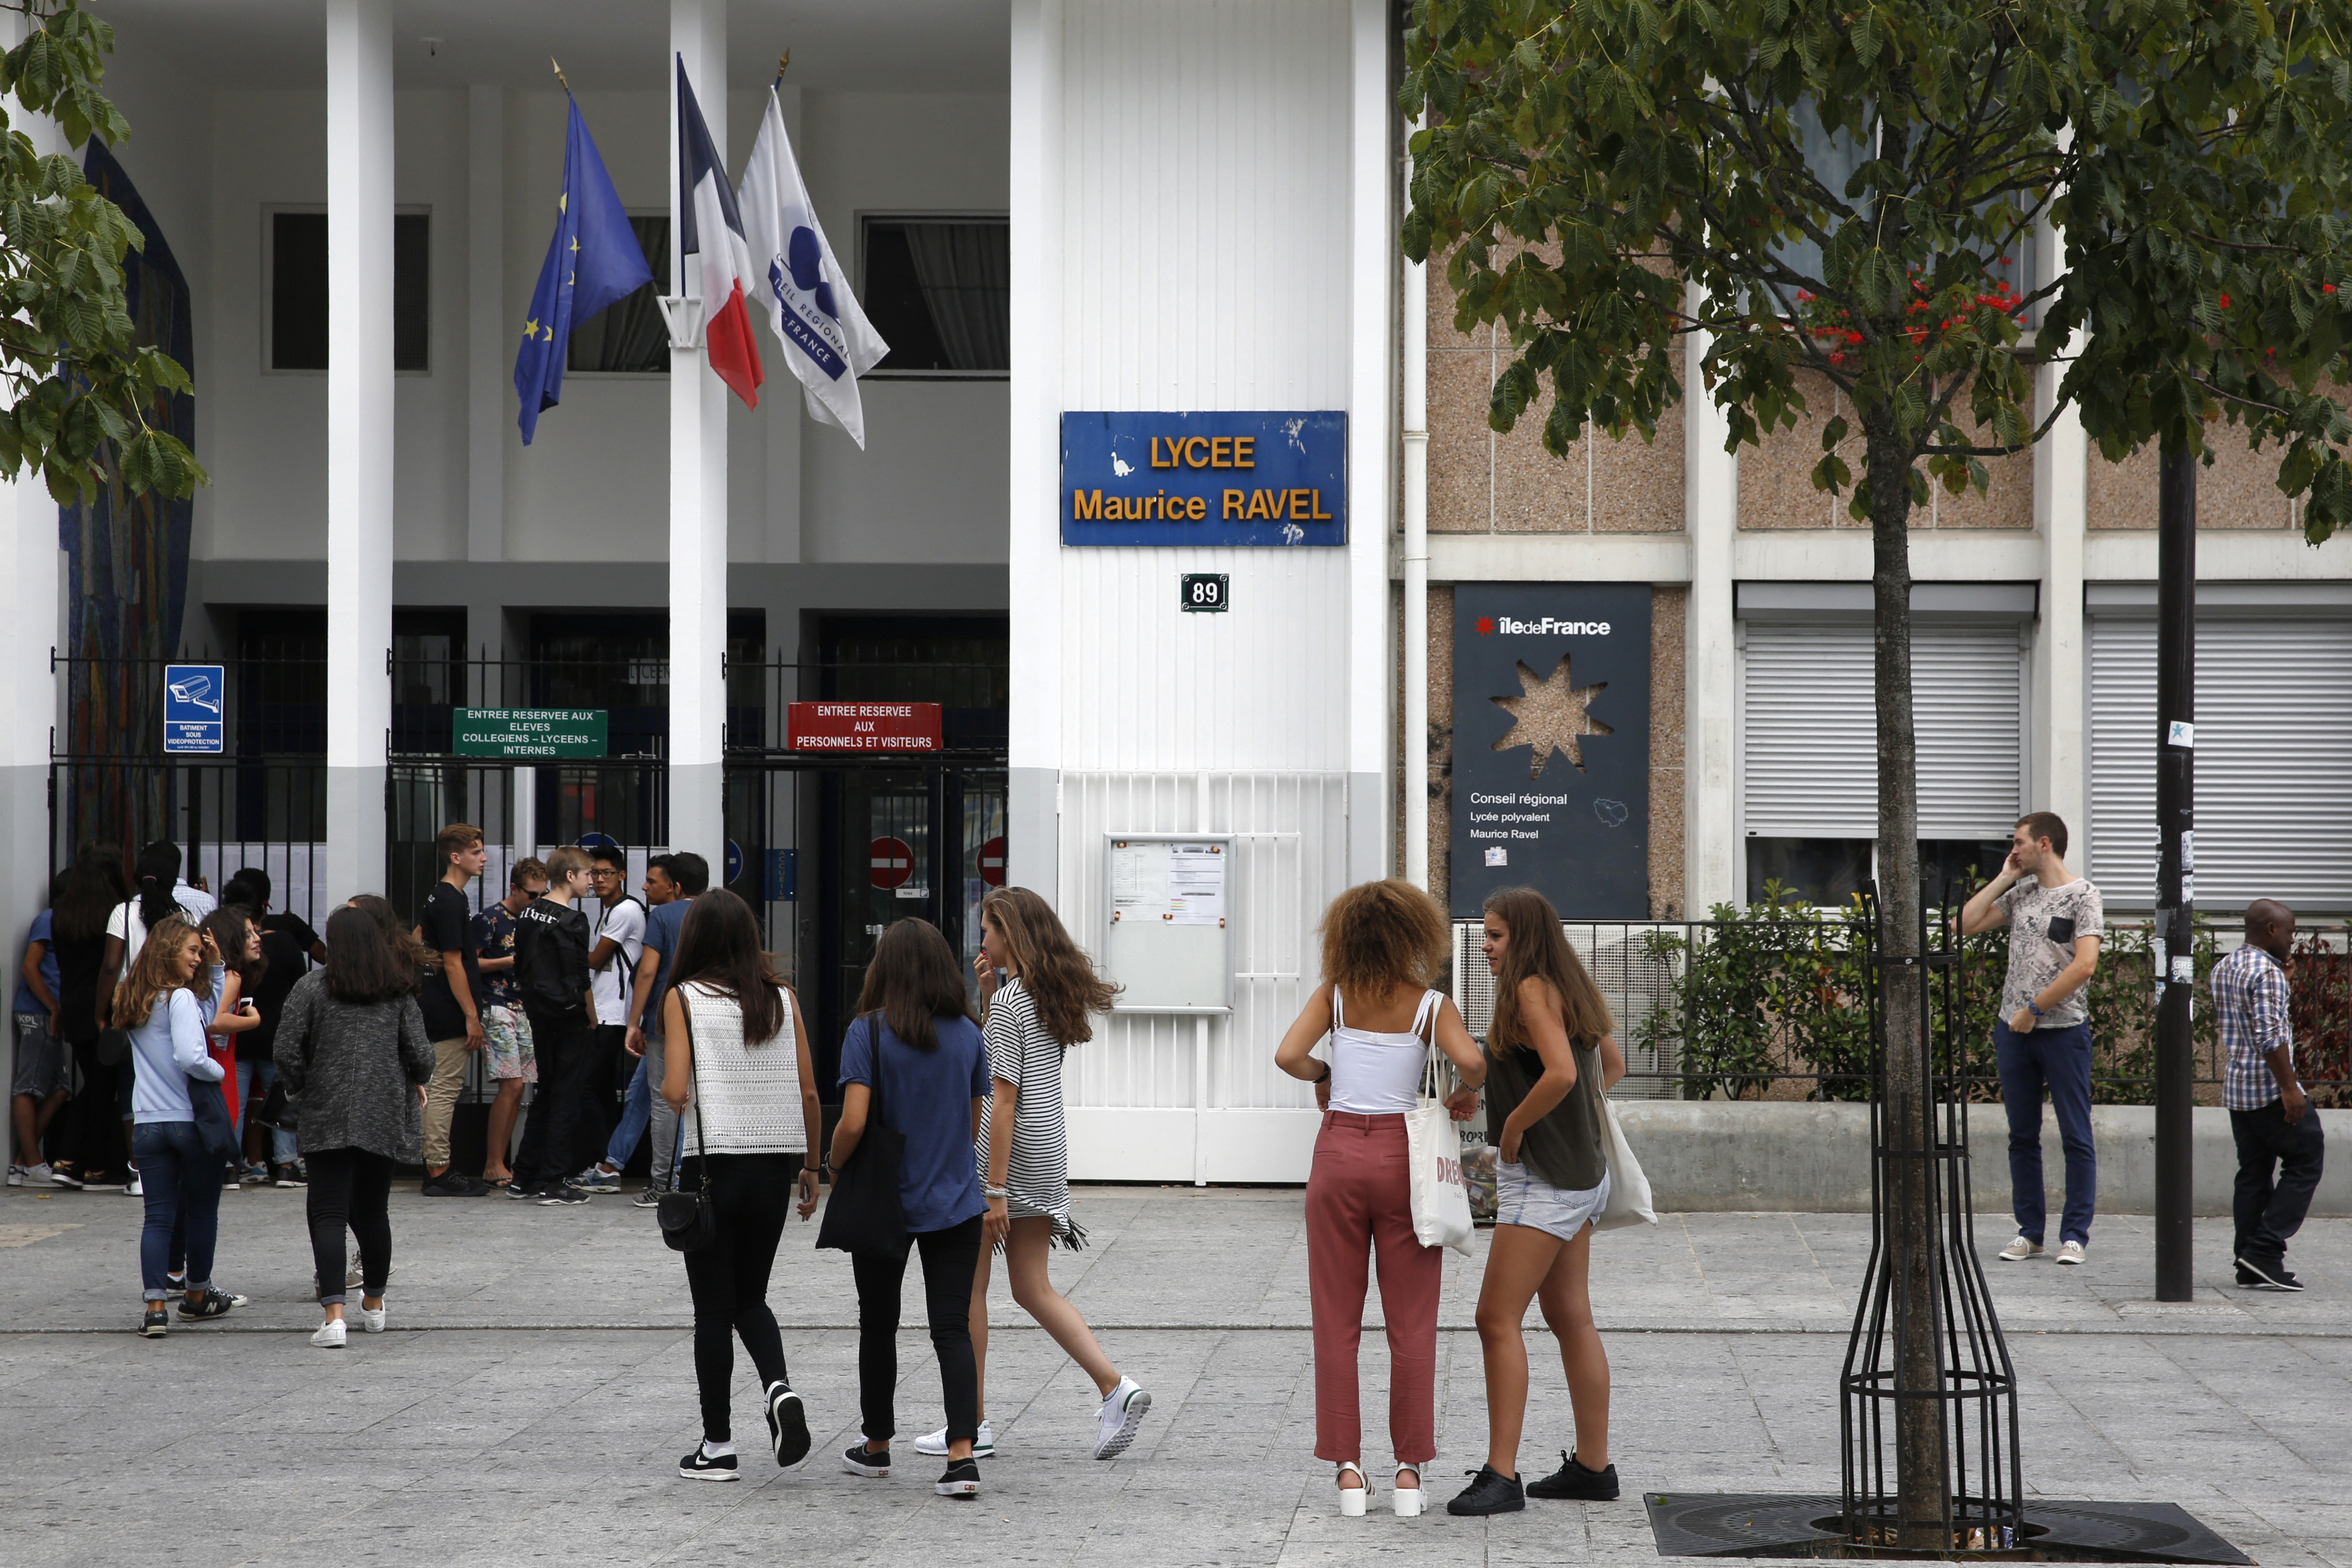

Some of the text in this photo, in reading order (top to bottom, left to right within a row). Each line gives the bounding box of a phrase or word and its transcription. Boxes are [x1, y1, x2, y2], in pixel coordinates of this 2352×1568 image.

[1151, 436, 1255, 468] LYCEE
[1073, 488, 1332, 520] Maurice RAVEL
[1192, 583, 1218, 603] 89
[467, 710, 593, 720] ENTREE RESERVEE AUX
[818, 706, 912, 717] ENTREE RESERVEE
[510, 722, 550, 731] ELEVES
[854, 721, 875, 732] AUX
[463, 733, 529, 743] COLLEGIENS
[541, 735, 589, 744] LYCEENS
[797, 736, 932, 748] PERSONNELS ET VISITEURS
[503, 746, 556, 755] INTERNES
[1471, 792, 1568, 808] Conseil régional
[1470, 811, 1550, 824] Lycée polyvalent
[1470, 829, 1539, 840] Maurice Ravel
[19, 1014, 38, 1026] KPL
